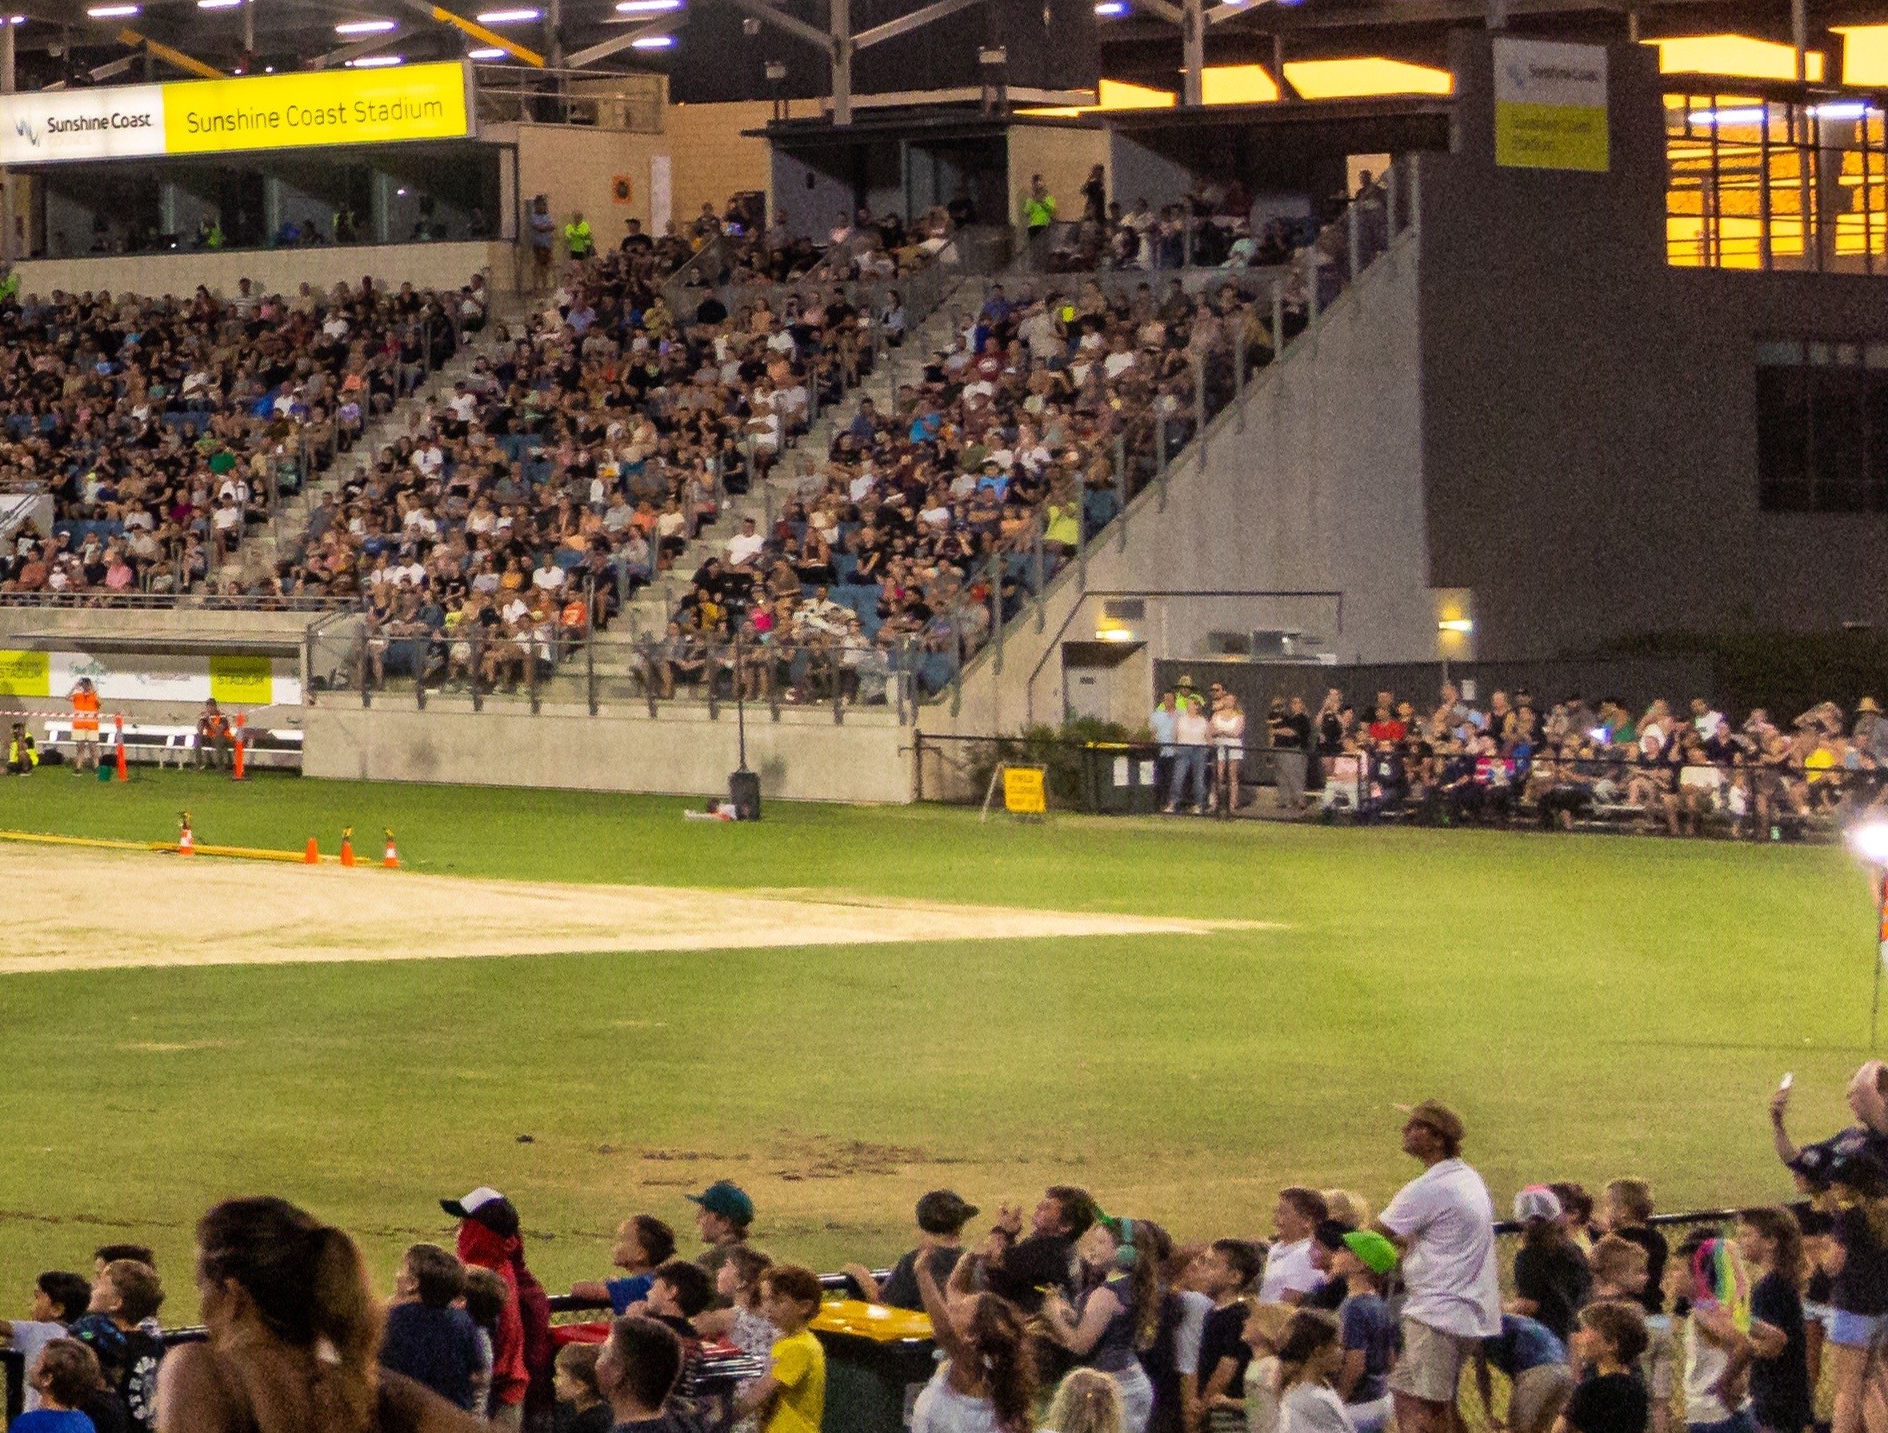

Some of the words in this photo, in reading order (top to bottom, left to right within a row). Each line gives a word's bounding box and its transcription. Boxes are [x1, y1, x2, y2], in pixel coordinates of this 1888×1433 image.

[47, 115, 109, 133] Sunshine
[112, 113, 151, 129] Coast
[187, 106, 279, 133] Sunshine
[287, 103, 347, 127] Coast
[354, 98, 443, 123] Stadium
